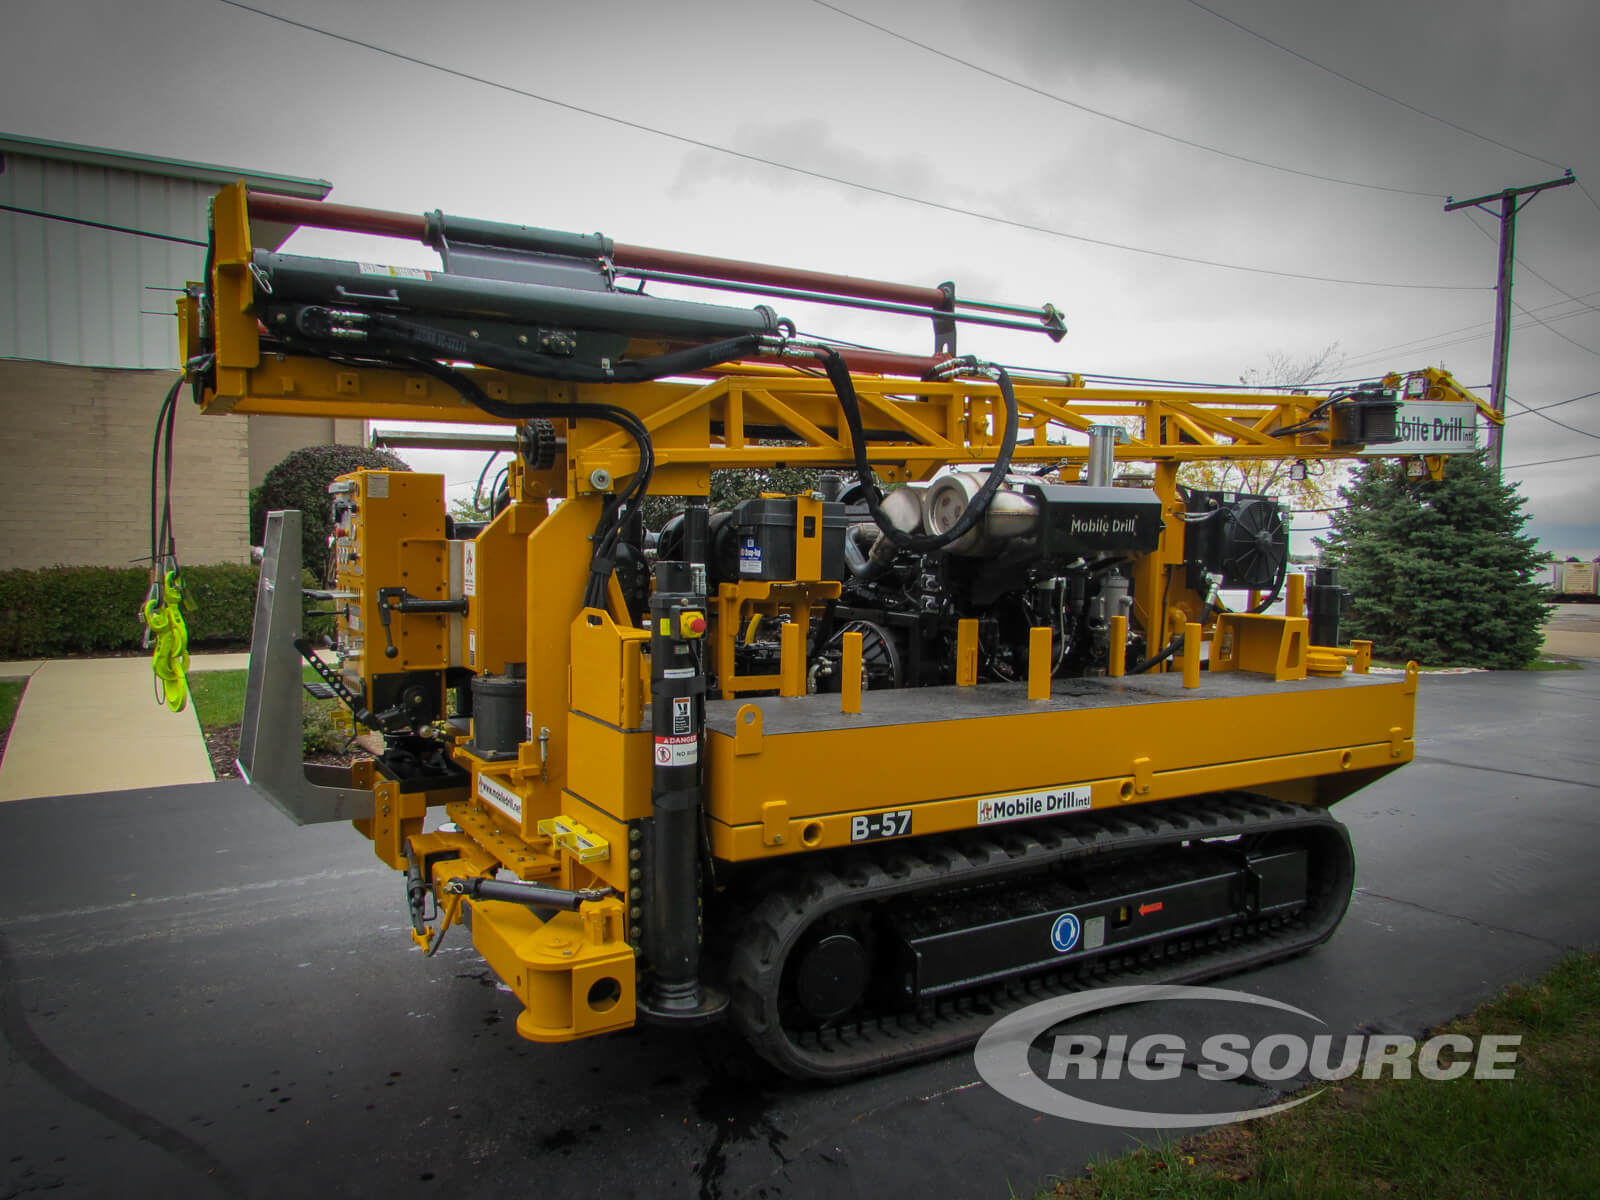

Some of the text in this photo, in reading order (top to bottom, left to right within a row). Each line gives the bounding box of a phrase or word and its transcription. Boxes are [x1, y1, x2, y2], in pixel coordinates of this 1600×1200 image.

[1433, 416, 1463, 441] Drill
[1071, 519, 1136, 532] Mobile Drill
[993, 796, 1042, 818] Mobile
[1046, 790, 1075, 811] Drill
[852, 810, 912, 841] B-57
